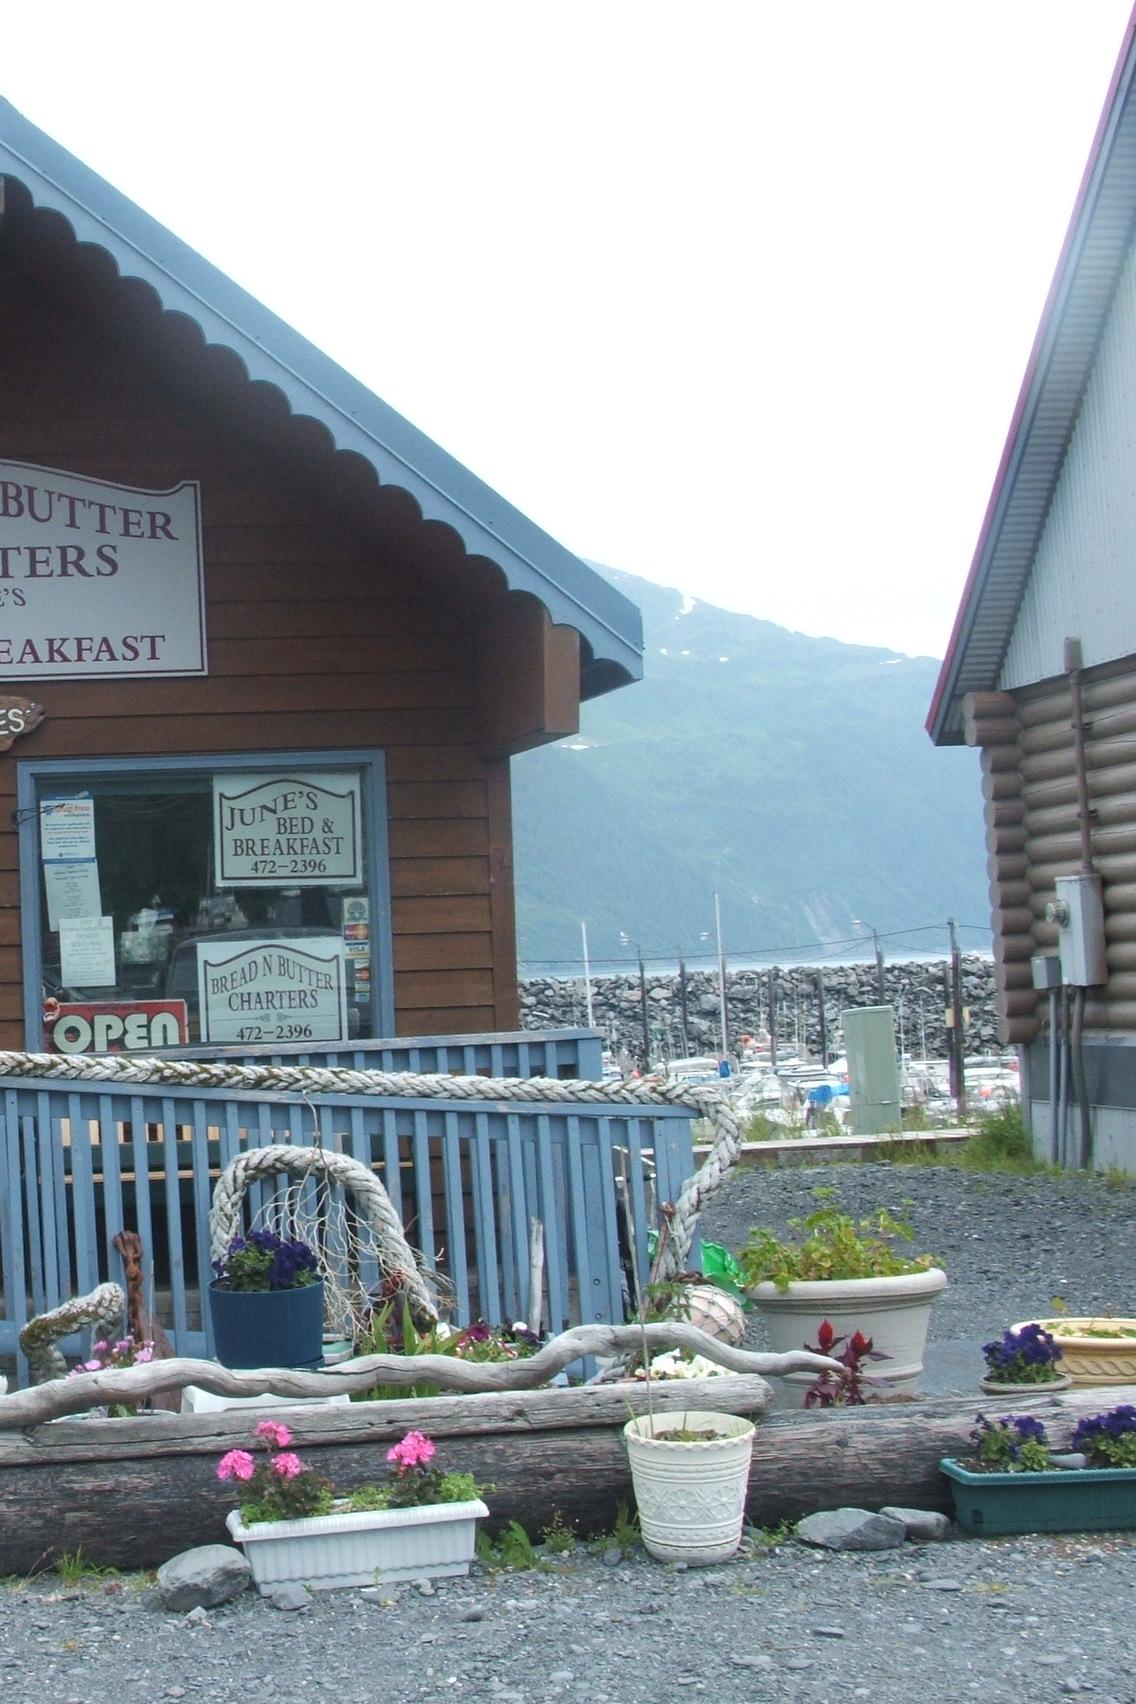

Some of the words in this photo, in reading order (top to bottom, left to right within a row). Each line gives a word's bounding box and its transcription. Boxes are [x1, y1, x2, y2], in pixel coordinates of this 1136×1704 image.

[225, 791, 318, 831] JUNE'S
[276, 816, 314, 835] BED
[321, 818, 334, 834] &
[232, 837, 344, 857] BREAKFAST
[250, 860, 326, 874] 472-2396
[210, 960, 258, 995] BREAD
[262, 954, 272, 977] N
[277, 955, 334, 991] BUTTER
[228, 989, 319, 1012] CHARTERS
[53, 1012, 180, 1054] OPEN
[236, 1024, 313, 1041] 472-2396
